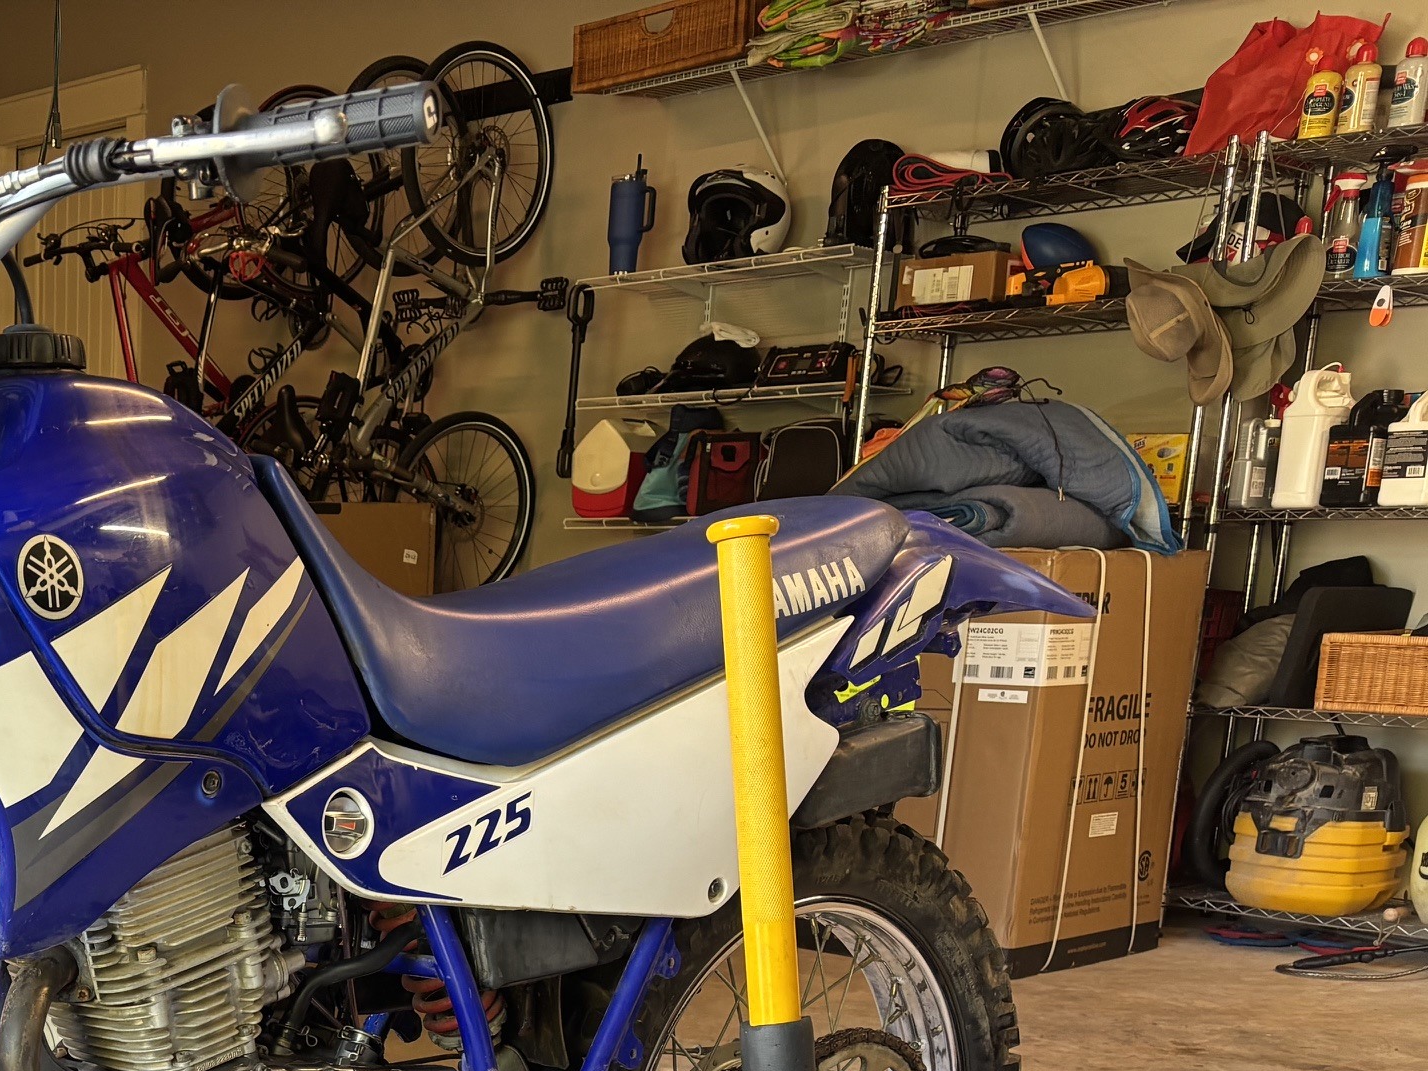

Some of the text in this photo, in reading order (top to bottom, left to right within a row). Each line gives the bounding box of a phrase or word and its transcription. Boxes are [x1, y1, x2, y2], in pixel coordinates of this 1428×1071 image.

[234, 339, 301, 424] SPECIALIZED
[772, 556, 866, 619] AMAHA
[1097, 730, 1119, 747] NOT
[442, 792, 533, 876] 225
